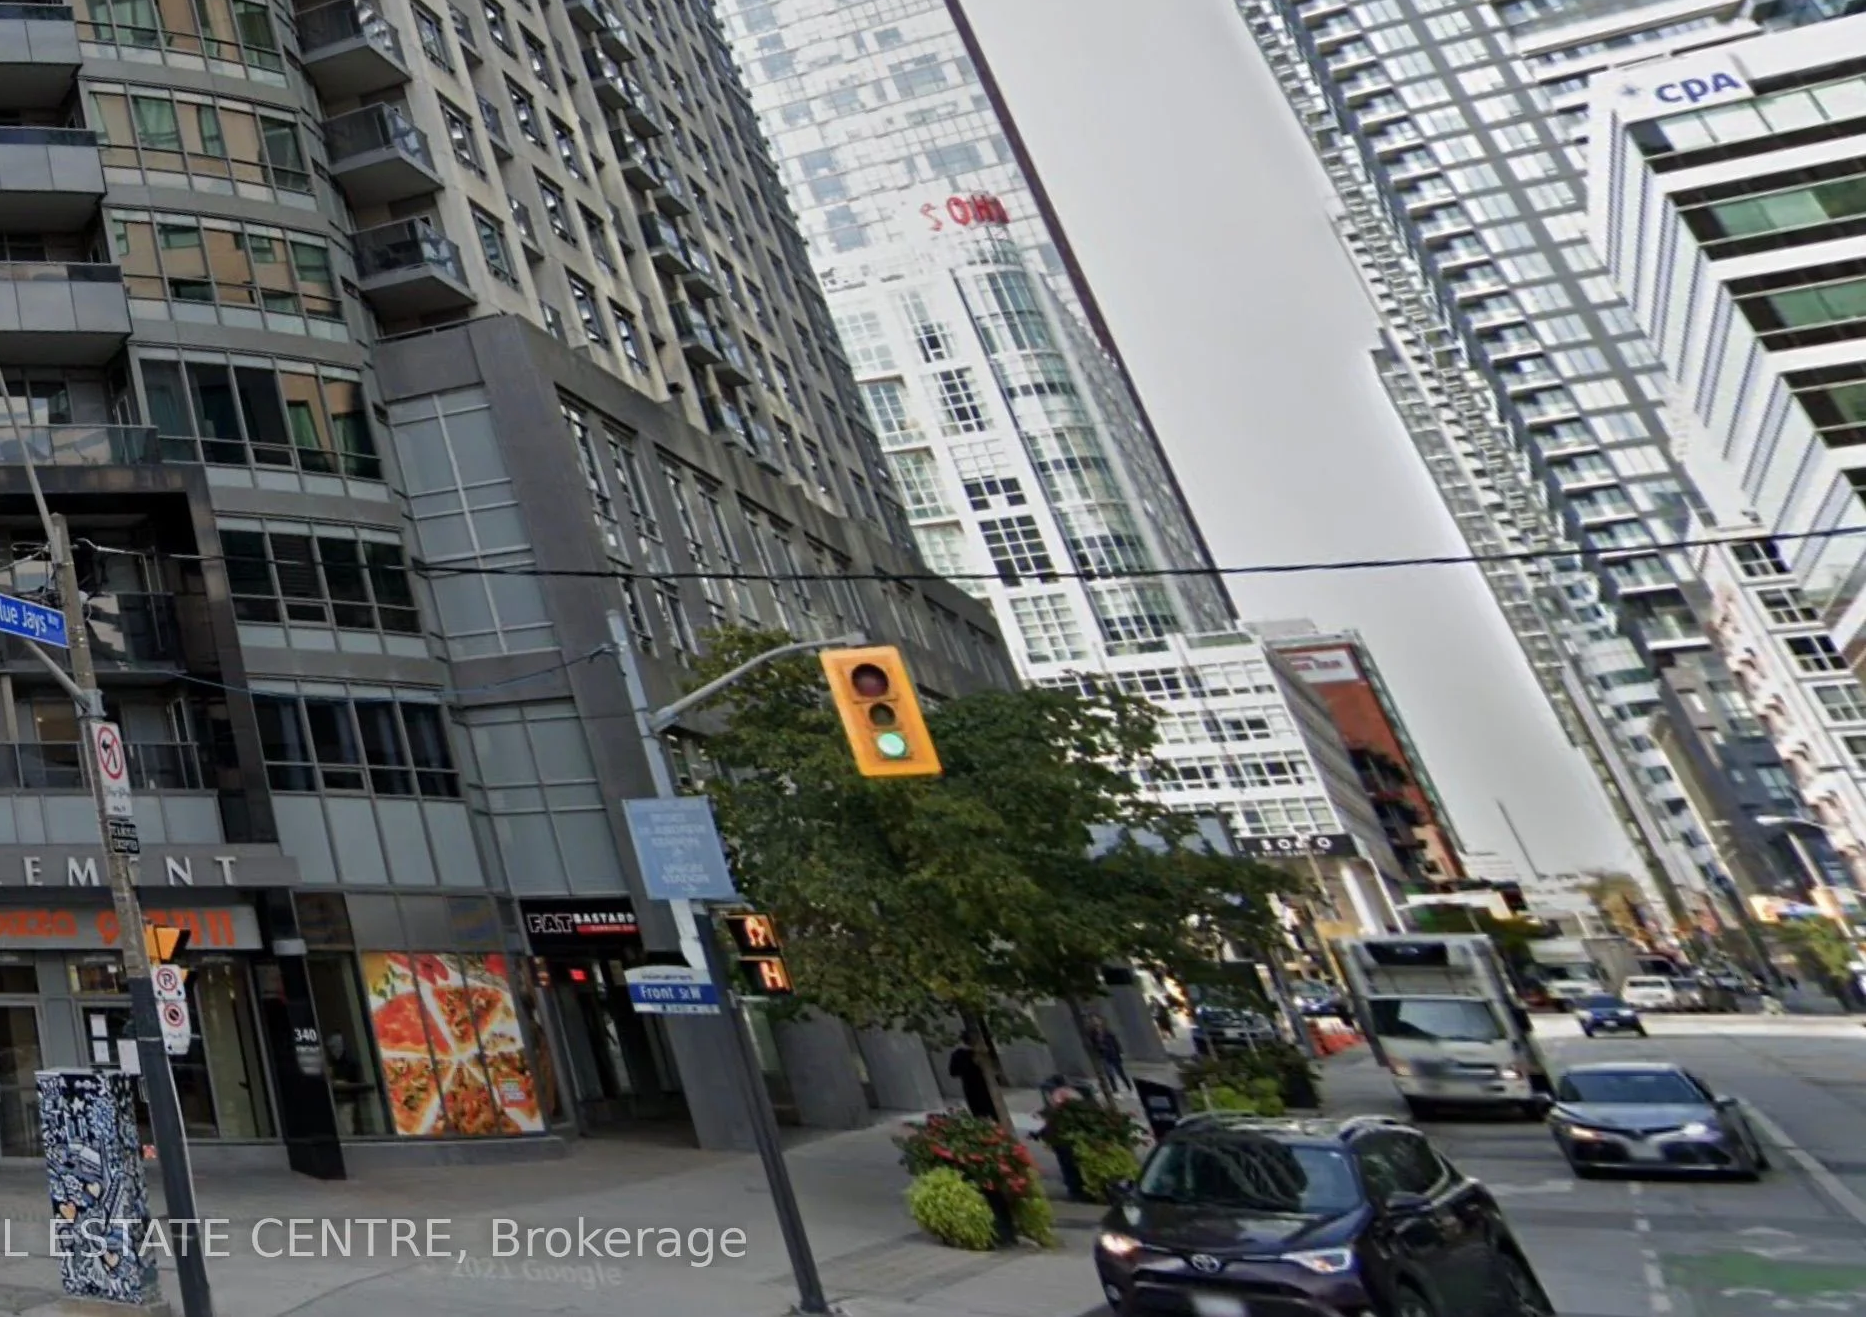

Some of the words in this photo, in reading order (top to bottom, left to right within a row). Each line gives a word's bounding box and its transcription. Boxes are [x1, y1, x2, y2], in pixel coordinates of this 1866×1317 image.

[21, 604, 48, 637] Jays
[526, 912, 574, 934] FAT
[573, 911, 636, 924] BASTARD
[639, 985, 674, 1000] Front
[294, 1027, 318, 1042] 340
